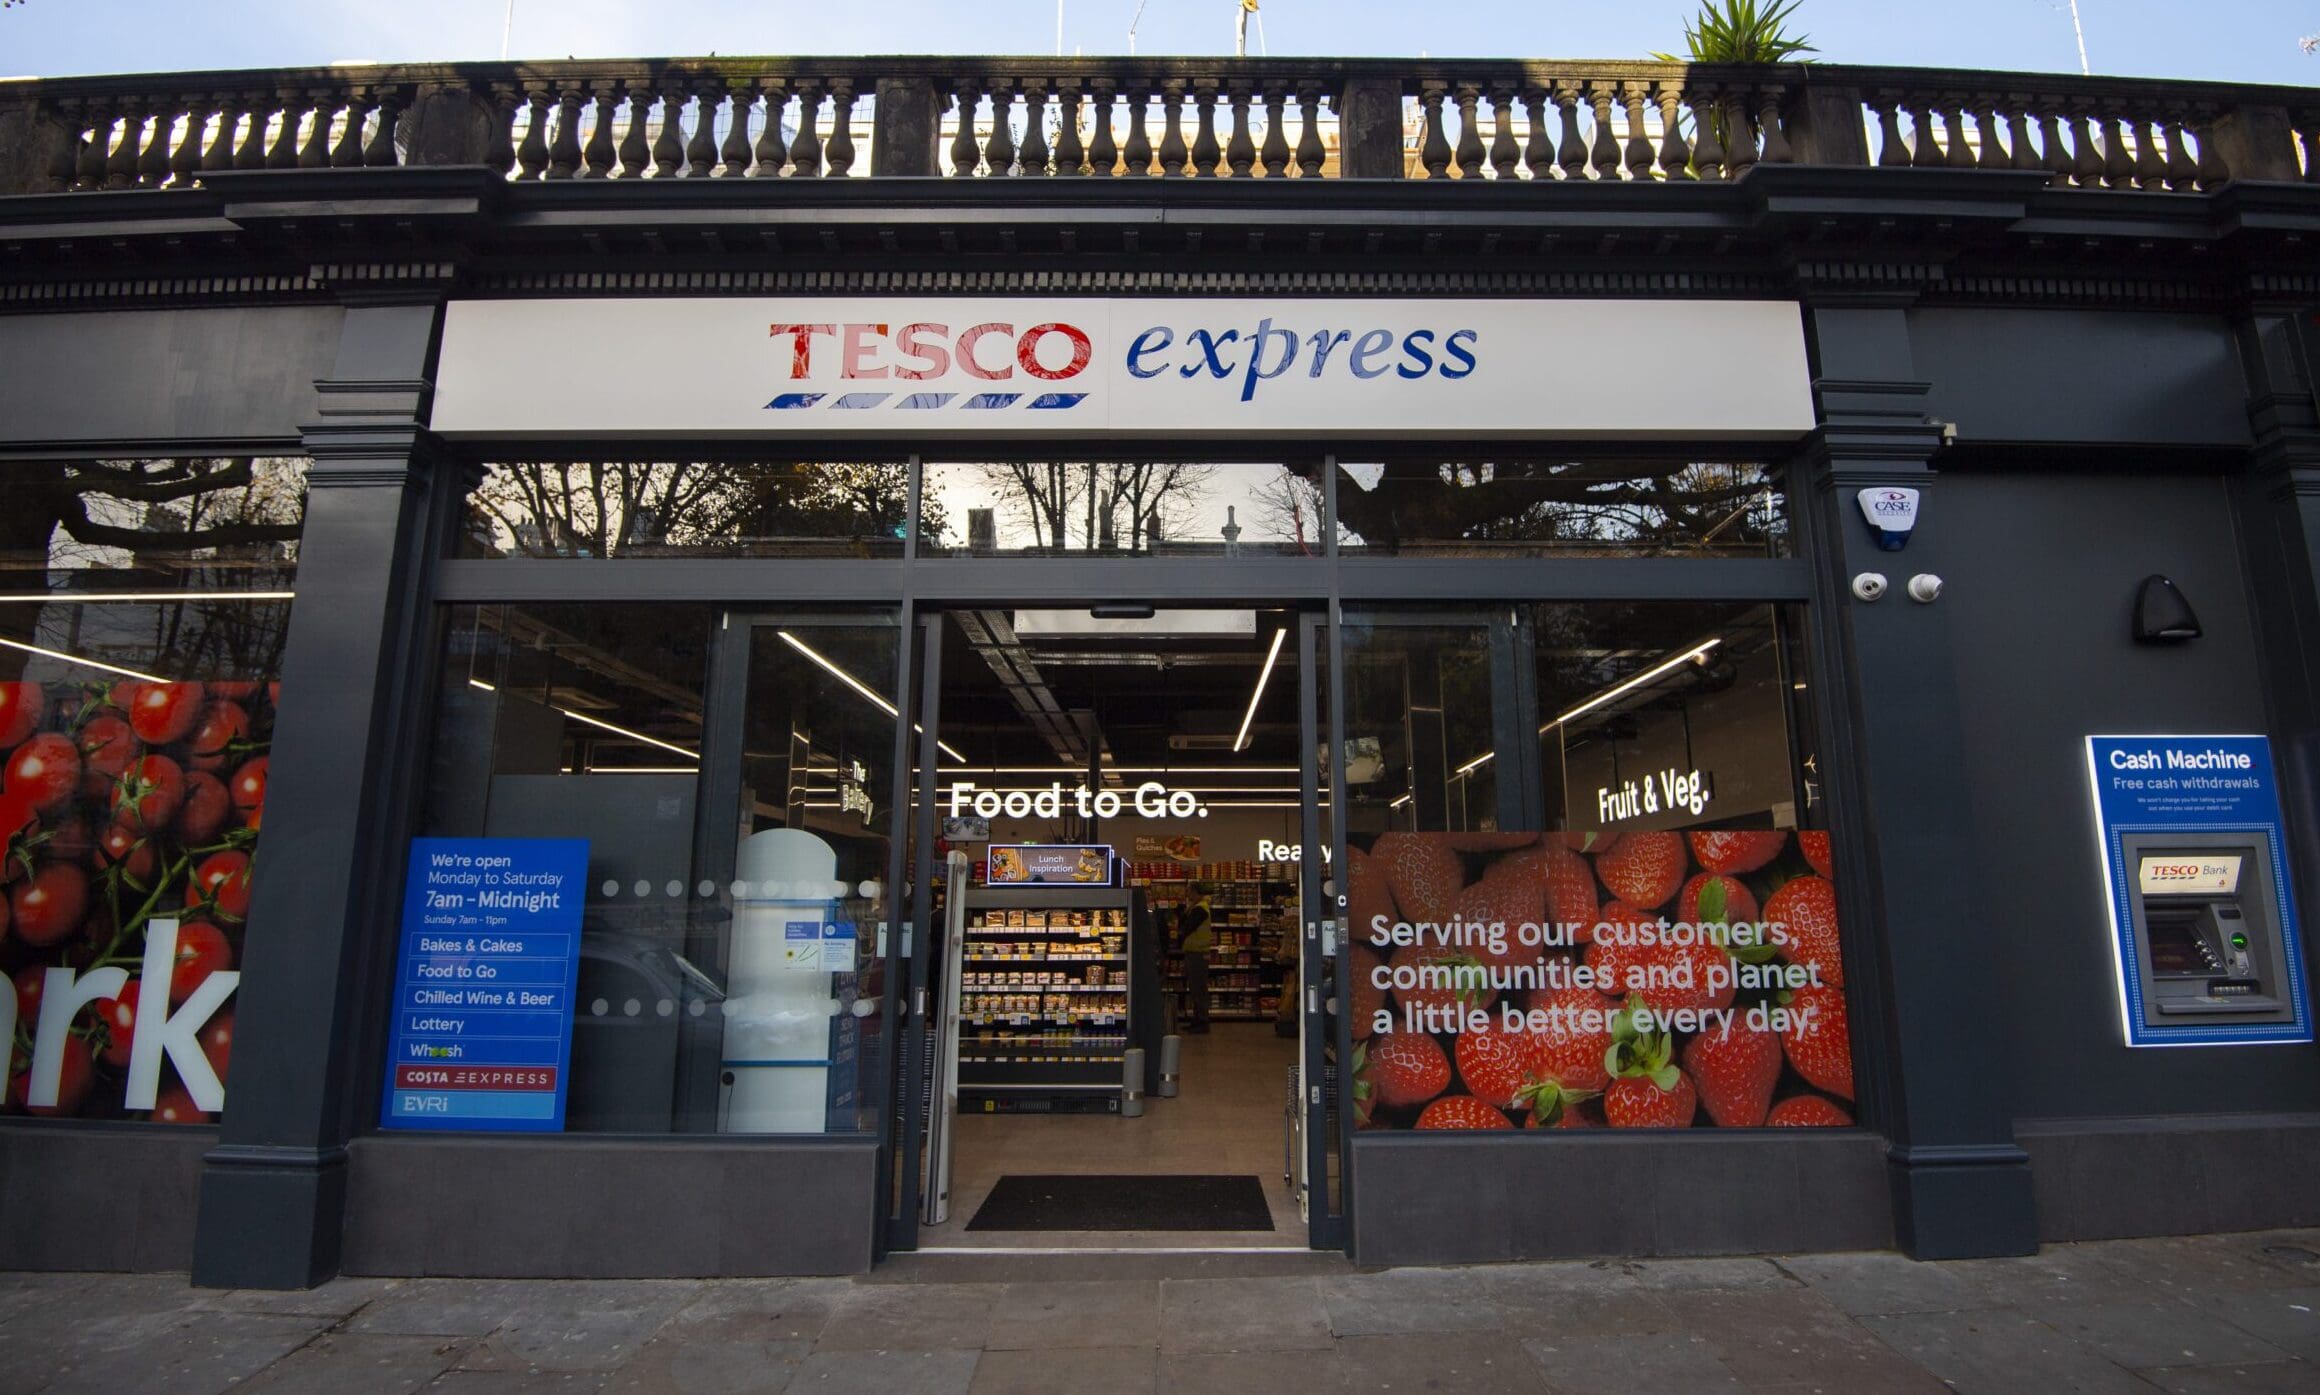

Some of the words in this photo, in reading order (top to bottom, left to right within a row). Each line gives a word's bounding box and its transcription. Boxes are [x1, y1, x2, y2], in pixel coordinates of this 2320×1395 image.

[770, 322, 1093, 381] TESCO
[1126, 317, 1478, 402] express
[1875, 501, 1911, 512] CASE
[2110, 749, 2162, 769] Cash
[2113, 777, 2144, 789] Free
[2147, 777, 2178, 789] cash
[2181, 776, 2260, 789] withdrawals
[950, 782, 1061, 818] Food
[1074, 783, 1121, 818] to
[1134, 781, 1209, 818] Go.
[1598, 780, 1641, 823] Fruit
[1644, 775, 1658, 812] &
[1661, 768, 1710, 816] Veg.
[1038, 855, 1064, 863] Lunch
[1258, 839, 1332, 863] Reay
[431, 854, 471, 867] We're
[475, 856, 511, 870] open
[1029, 864, 1073, 874] Inspiration
[2152, 865, 2199, 876] TESCO
[2202, 864, 2229, 875] Bank
[428, 871, 480, 887] Monday
[485, 873, 499, 885] to
[502, 871, 563, 888] Saturday
[425, 890, 463, 908] 7am
[478, 890, 560, 912] Midnight
[424, 914, 456, 926] Sunday
[458, 915, 477, 924] 7am
[485, 915, 507, 926] 11pm
[1370, 913, 1507, 954] Serving
[1519, 921, 1582, 946] our
[1592, 915, 1800, 948] customers,
[420, 938, 461, 952] Bakes
[465, 939, 476, 952] &
[480, 938, 523, 953] Cakes
[417, 964, 453, 977] Food
[457, 966, 471, 978] to
[475, 965, 497, 978] Go
[1370, 957, 1614, 991] communities
[1625, 958, 1693, 990] and
[1707, 957, 1823, 998] planet
[414, 990, 463, 1004] Chilled
[467, 991, 502, 1005] Wine
[506, 992, 516, 1005] &
[520, 992, 555, 1006] Beer
[0, 919, 240, 1112] rk
[1372, 1006, 1394, 1034] a
[1405, 1001, 1490, 1034] little
[1502, 1001, 1619, 1034] better
[1631, 1007, 1735, 1041] every
[1746, 1001, 1819, 1041] day.
[411, 1016, 465, 1035] Lottery
[410, 1043, 463, 1058] Whoosh
[406, 1071, 449, 1084] COSTA
[468, 1072, 548, 1085] EXPRESS
